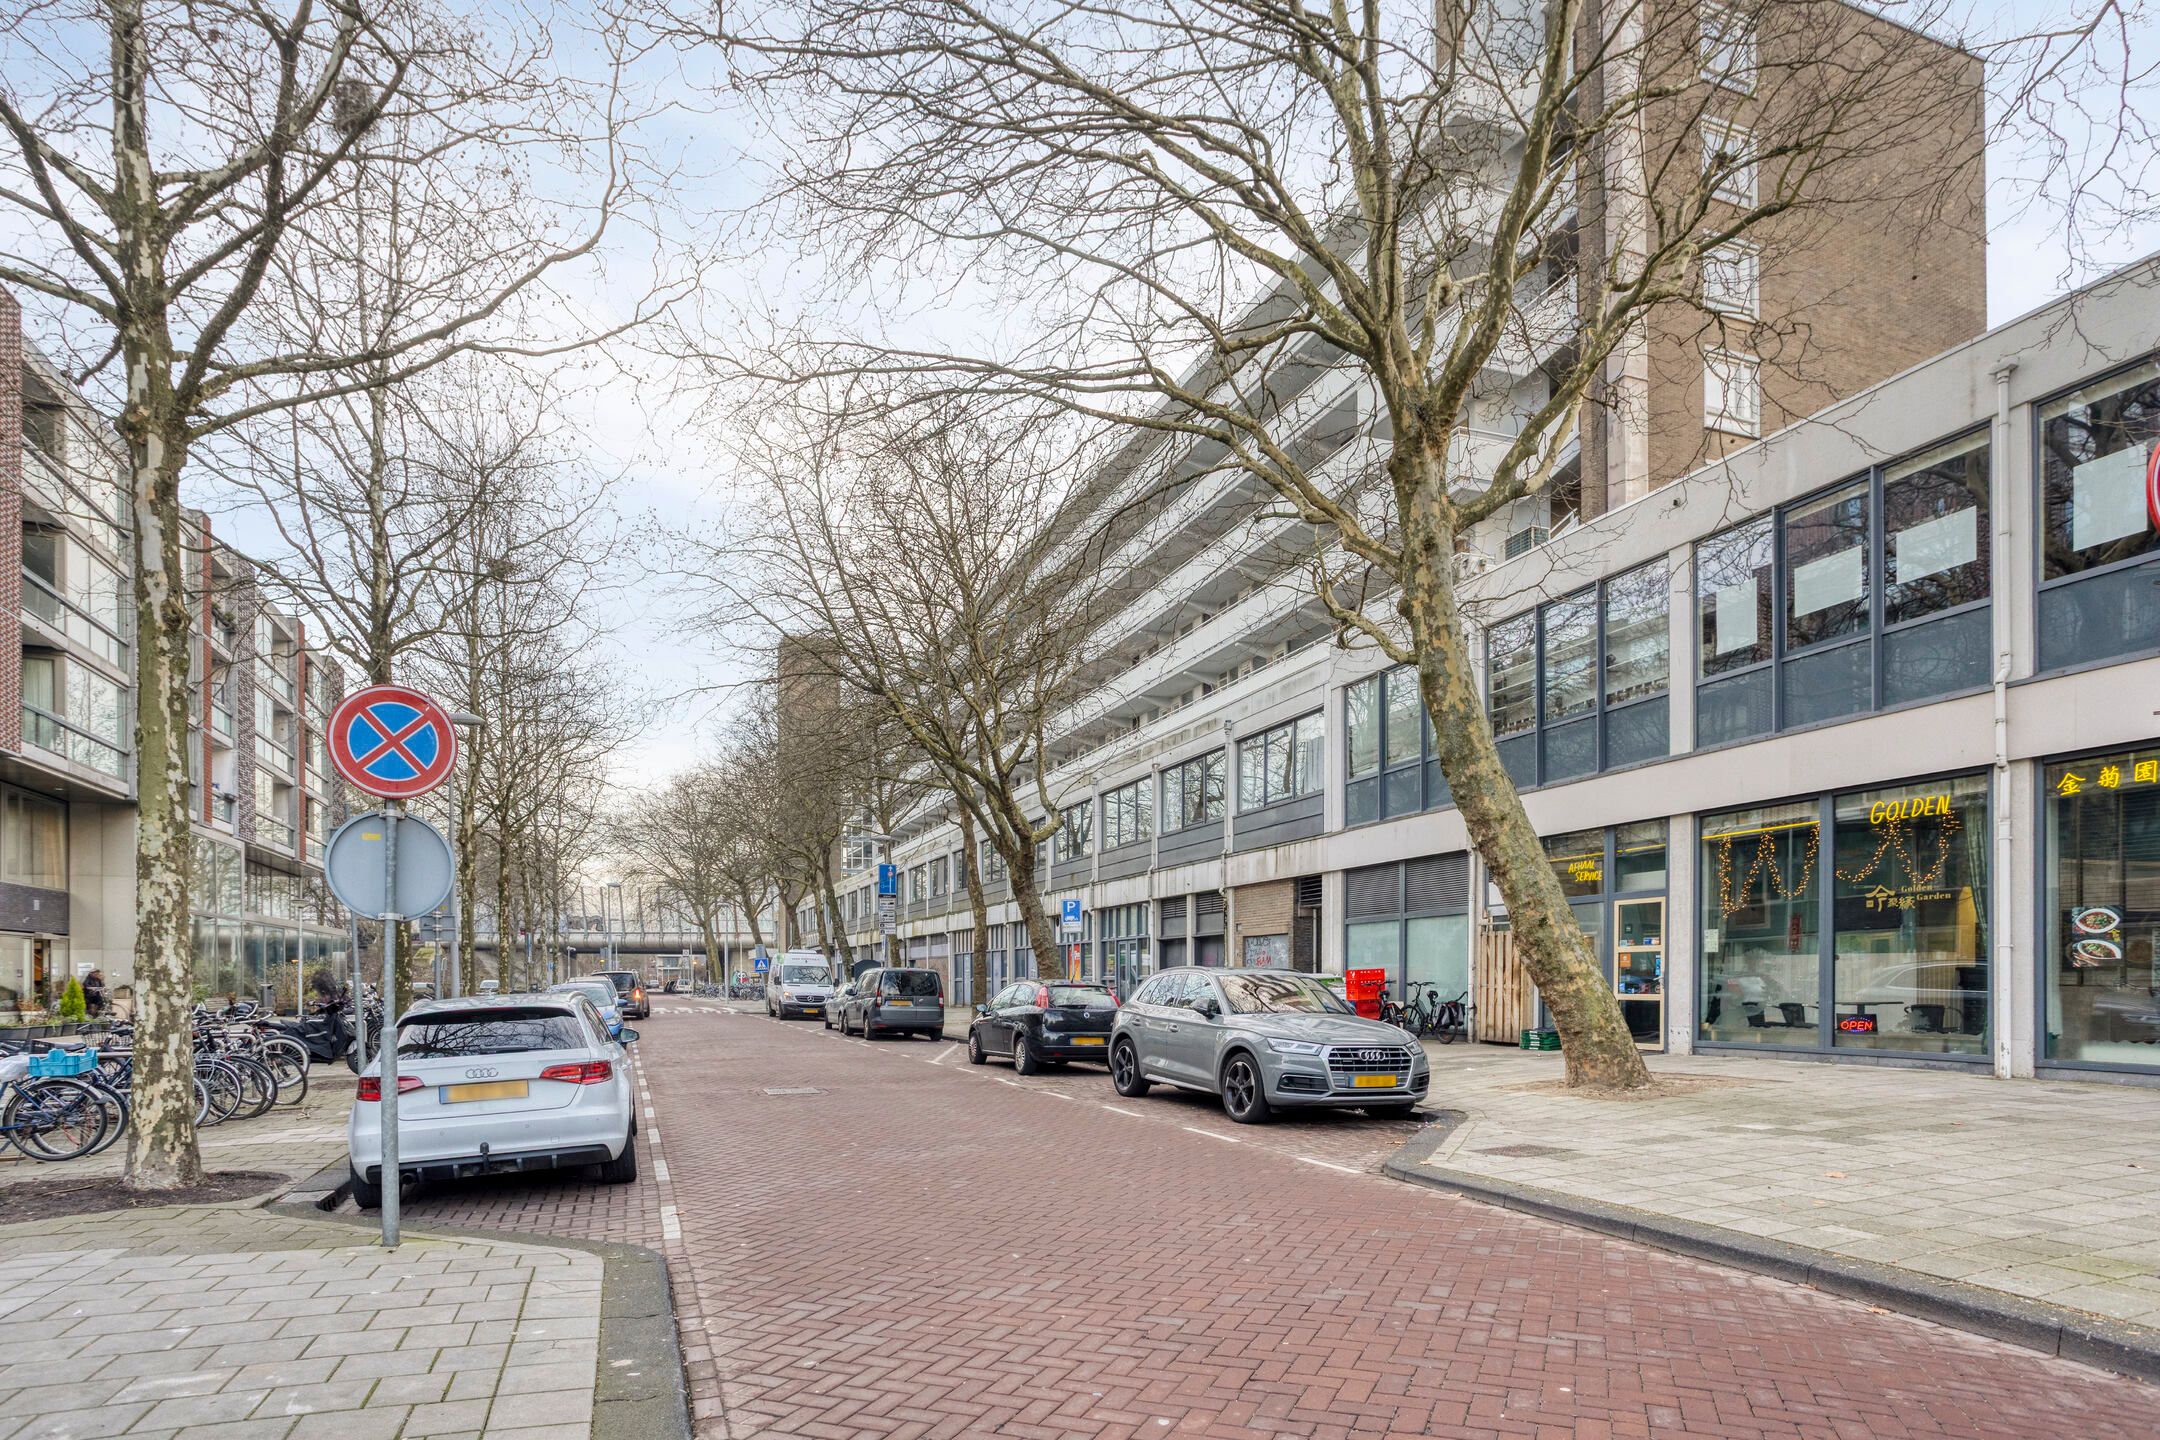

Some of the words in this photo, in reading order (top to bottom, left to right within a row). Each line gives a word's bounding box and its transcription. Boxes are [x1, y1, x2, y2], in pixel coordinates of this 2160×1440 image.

[2056, 760, 2158, 796] 金菊園
[1870, 794, 1950, 824] GOLDEN
[1575, 870, 1602, 881] SERVICE
[1901, 884, 1933, 893] Golden
[1916, 892, 1952, 901] Garden
[1066, 901, 1076, 913] P
[1840, 1020, 1873, 1031] OPEN
